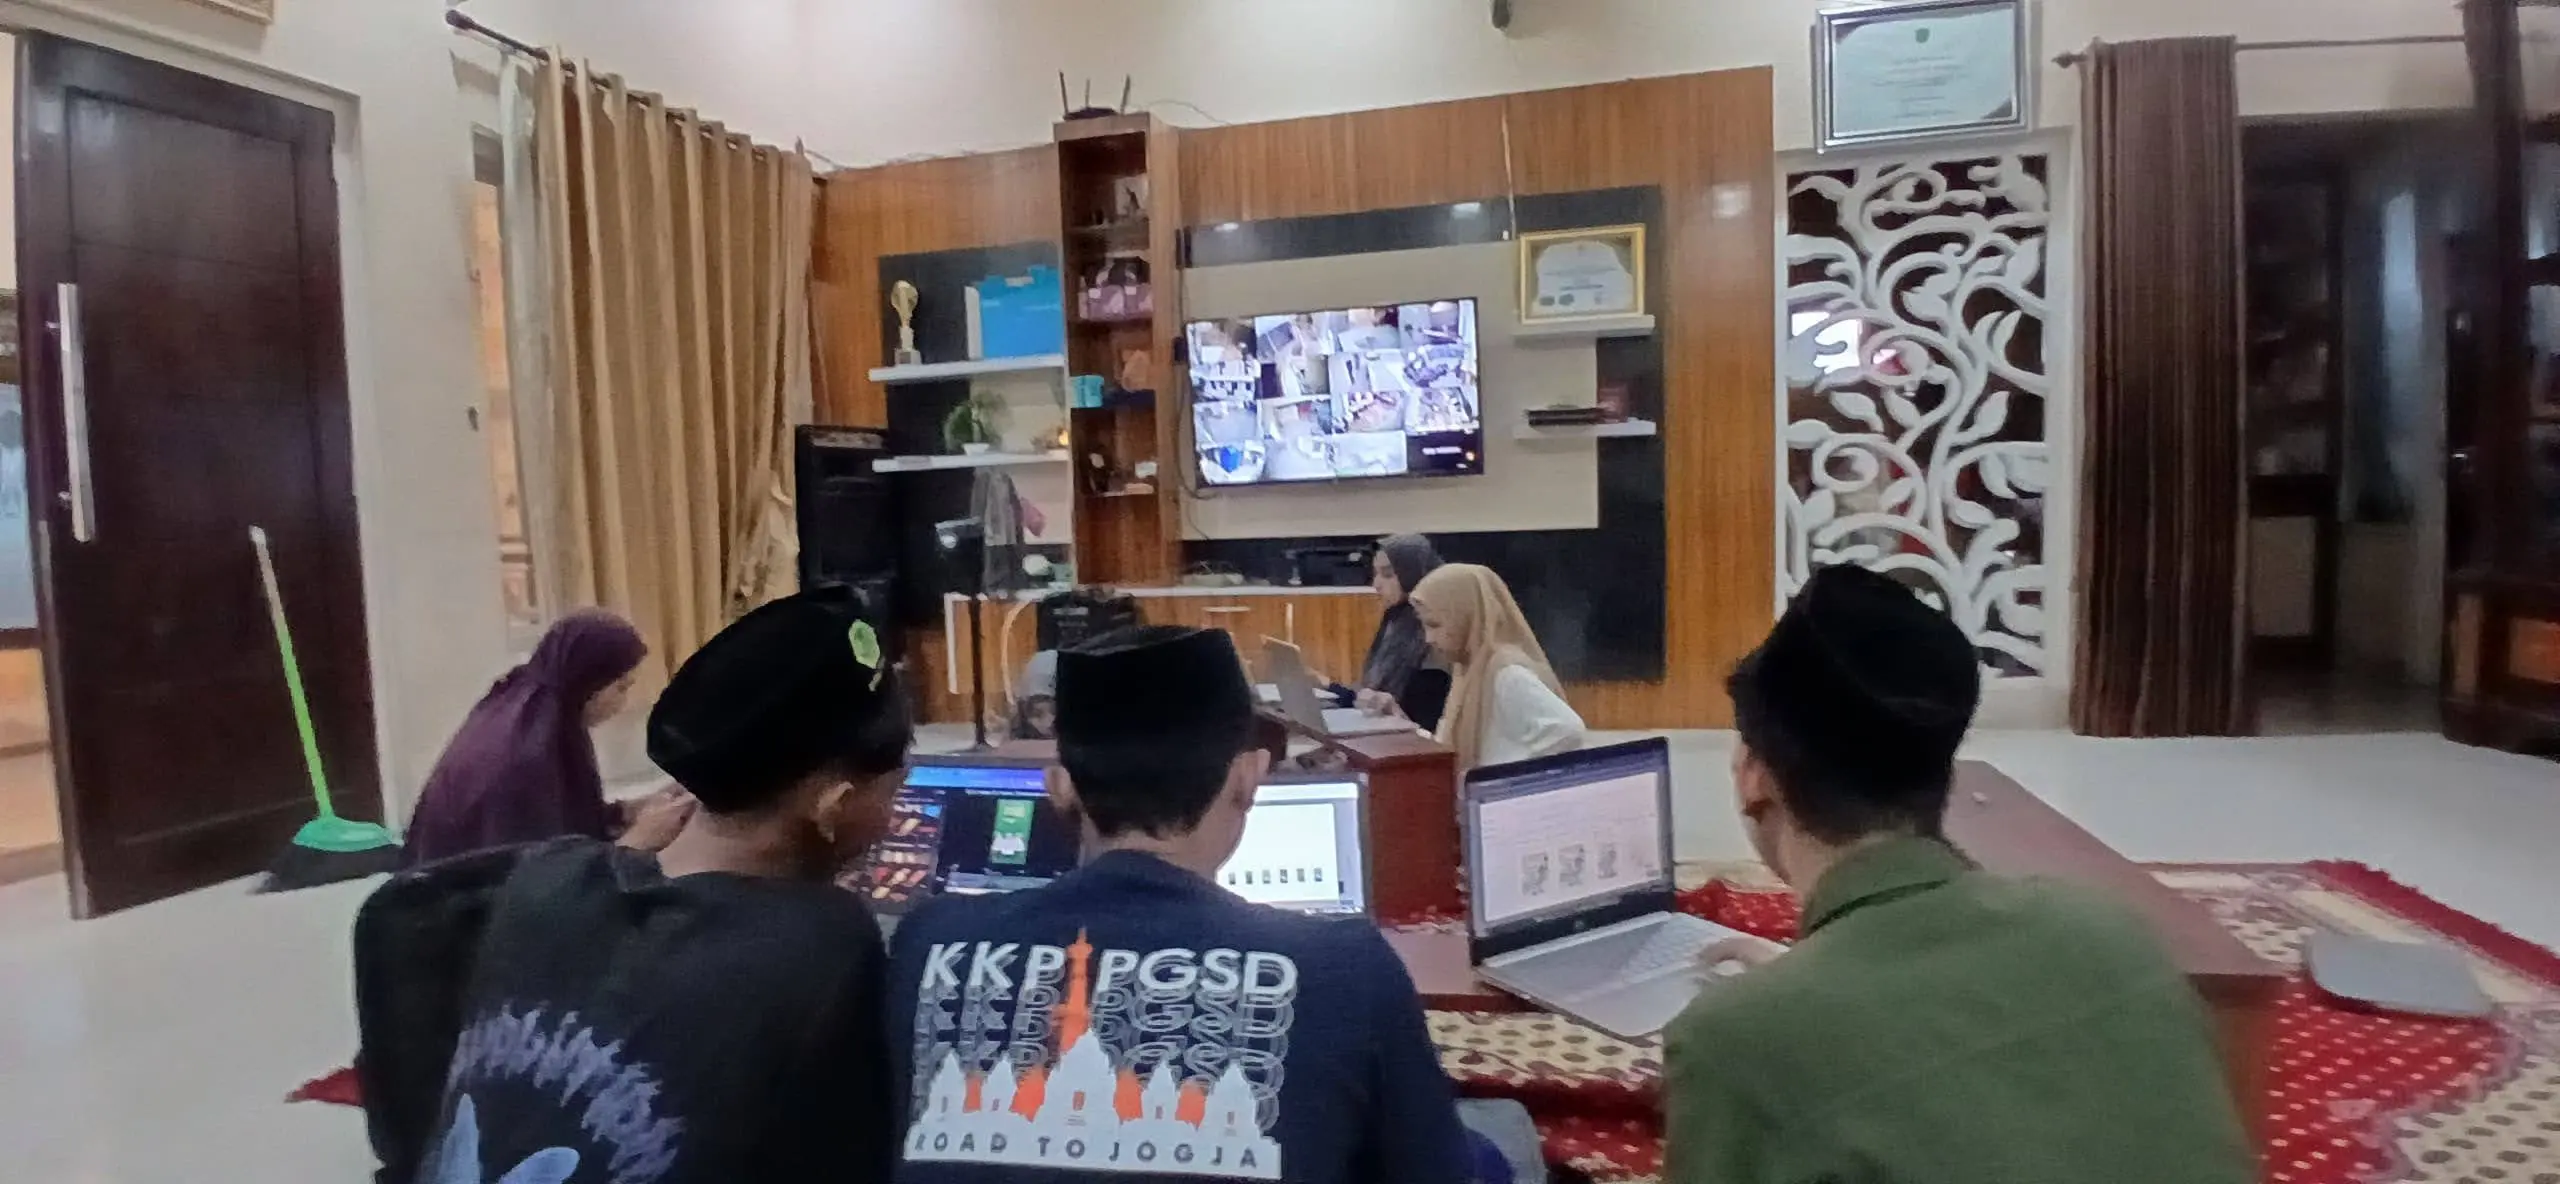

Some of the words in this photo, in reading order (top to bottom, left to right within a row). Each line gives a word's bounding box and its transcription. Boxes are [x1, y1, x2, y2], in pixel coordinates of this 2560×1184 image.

[920, 942, 1066, 990] KKP
[1096, 947, 1299, 998] PGSD
[1037, 1136, 1086, 1159] TO
[1108, 1143, 1258, 1169] JOGJA
